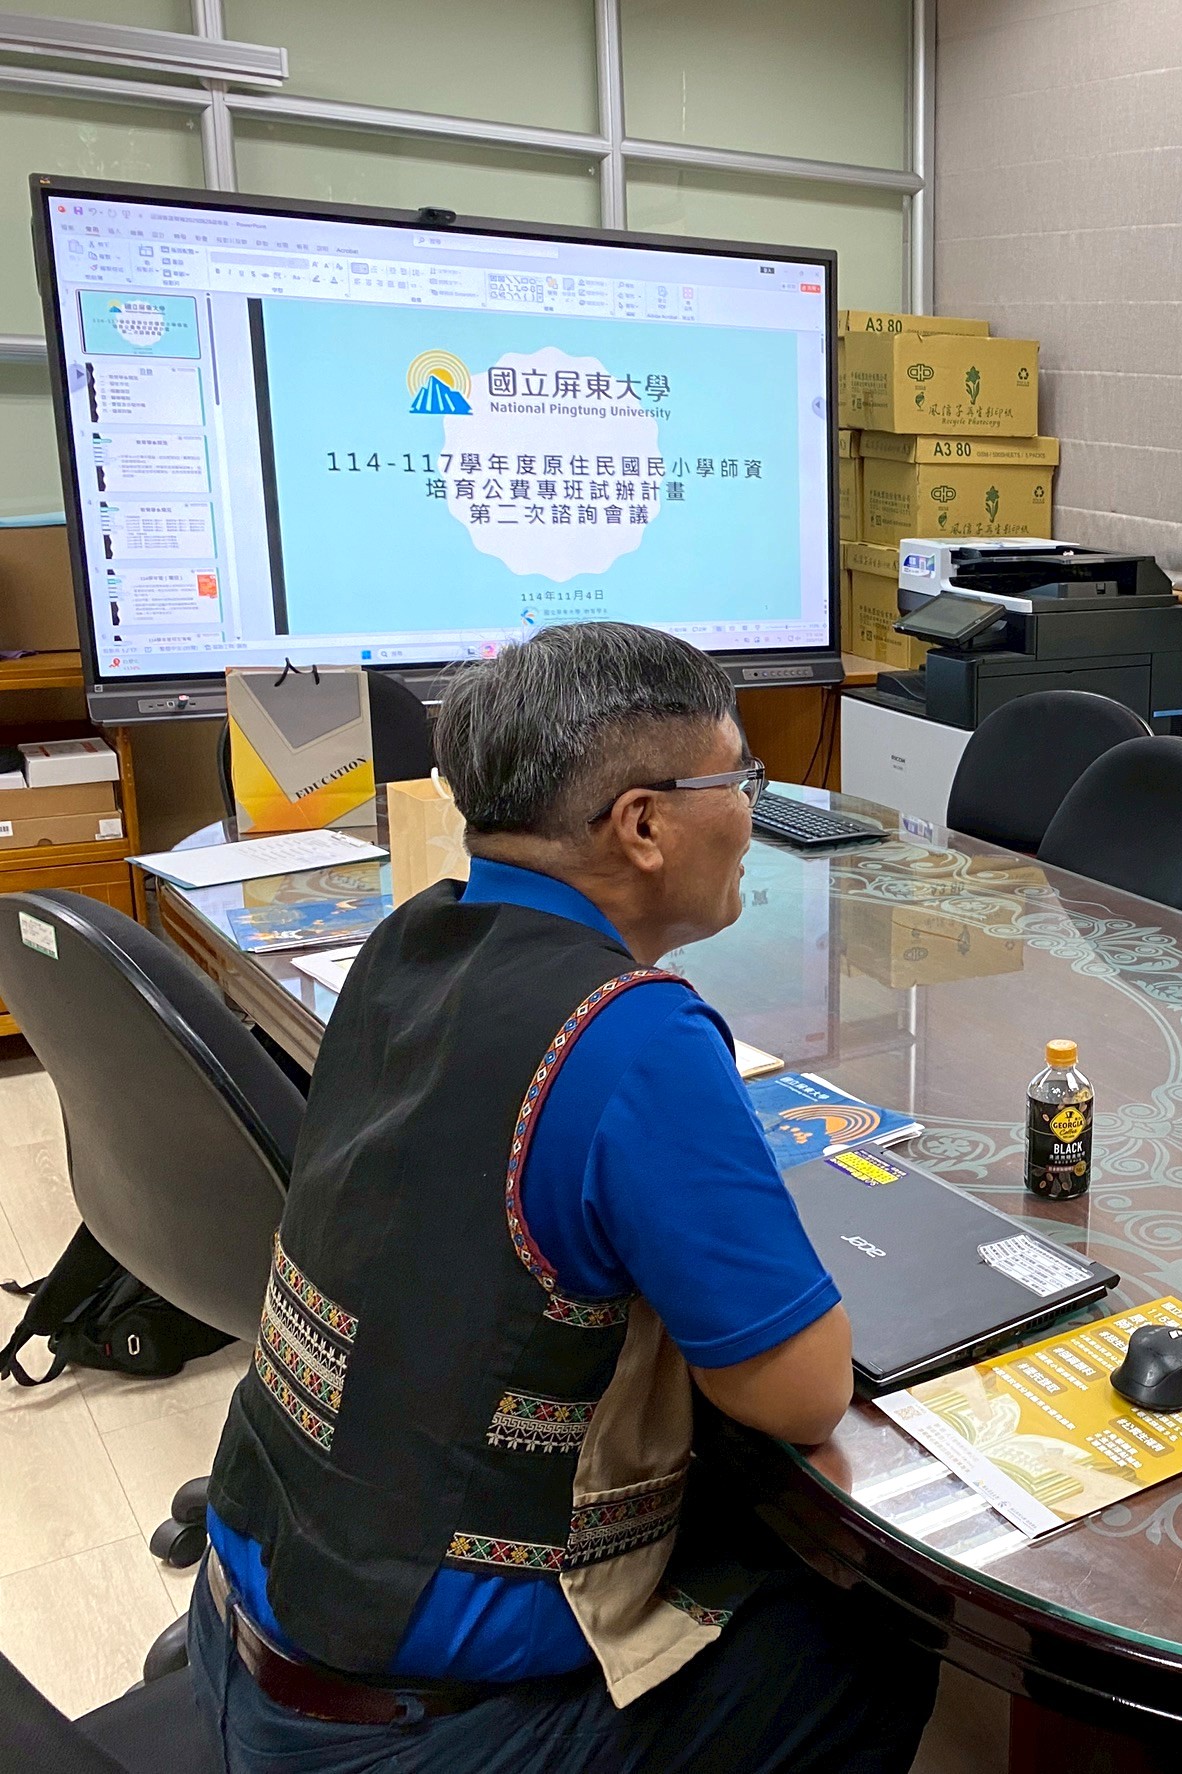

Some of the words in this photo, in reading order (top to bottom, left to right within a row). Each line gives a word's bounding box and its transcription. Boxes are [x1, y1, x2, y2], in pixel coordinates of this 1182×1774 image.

[865, 317, 883, 332] A3
[887, 319, 903, 333] 80
[487, 366, 671, 402] 國立屏東大學
[490, 401, 545, 415] National
[549, 403, 607, 419] Pingtung
[610, 405, 672, 421] University
[941, 417, 966, 429] Recycle
[933, 441, 952, 457] A3
[956, 442, 972, 457] 80
[326, 451, 763, 480] 114-117學年度原住民國民小學師資
[425, 476, 686, 502] 培育公費專班試辦計畫
[469, 502, 650, 526] 第二次諮詢會議
[520, 588, 604, 603] 114年11月4日
[295, 755, 367, 800] EDUCATION
[1053, 1119, 1083, 1130] GEORGIA
[1053, 1141, 1083, 1155] BLACK
[840, 1234, 886, 1258] acer
[1016, 1363, 1062, 1392] #優先錄取
[1115, 1418, 1165, 1451] #公費生福利
